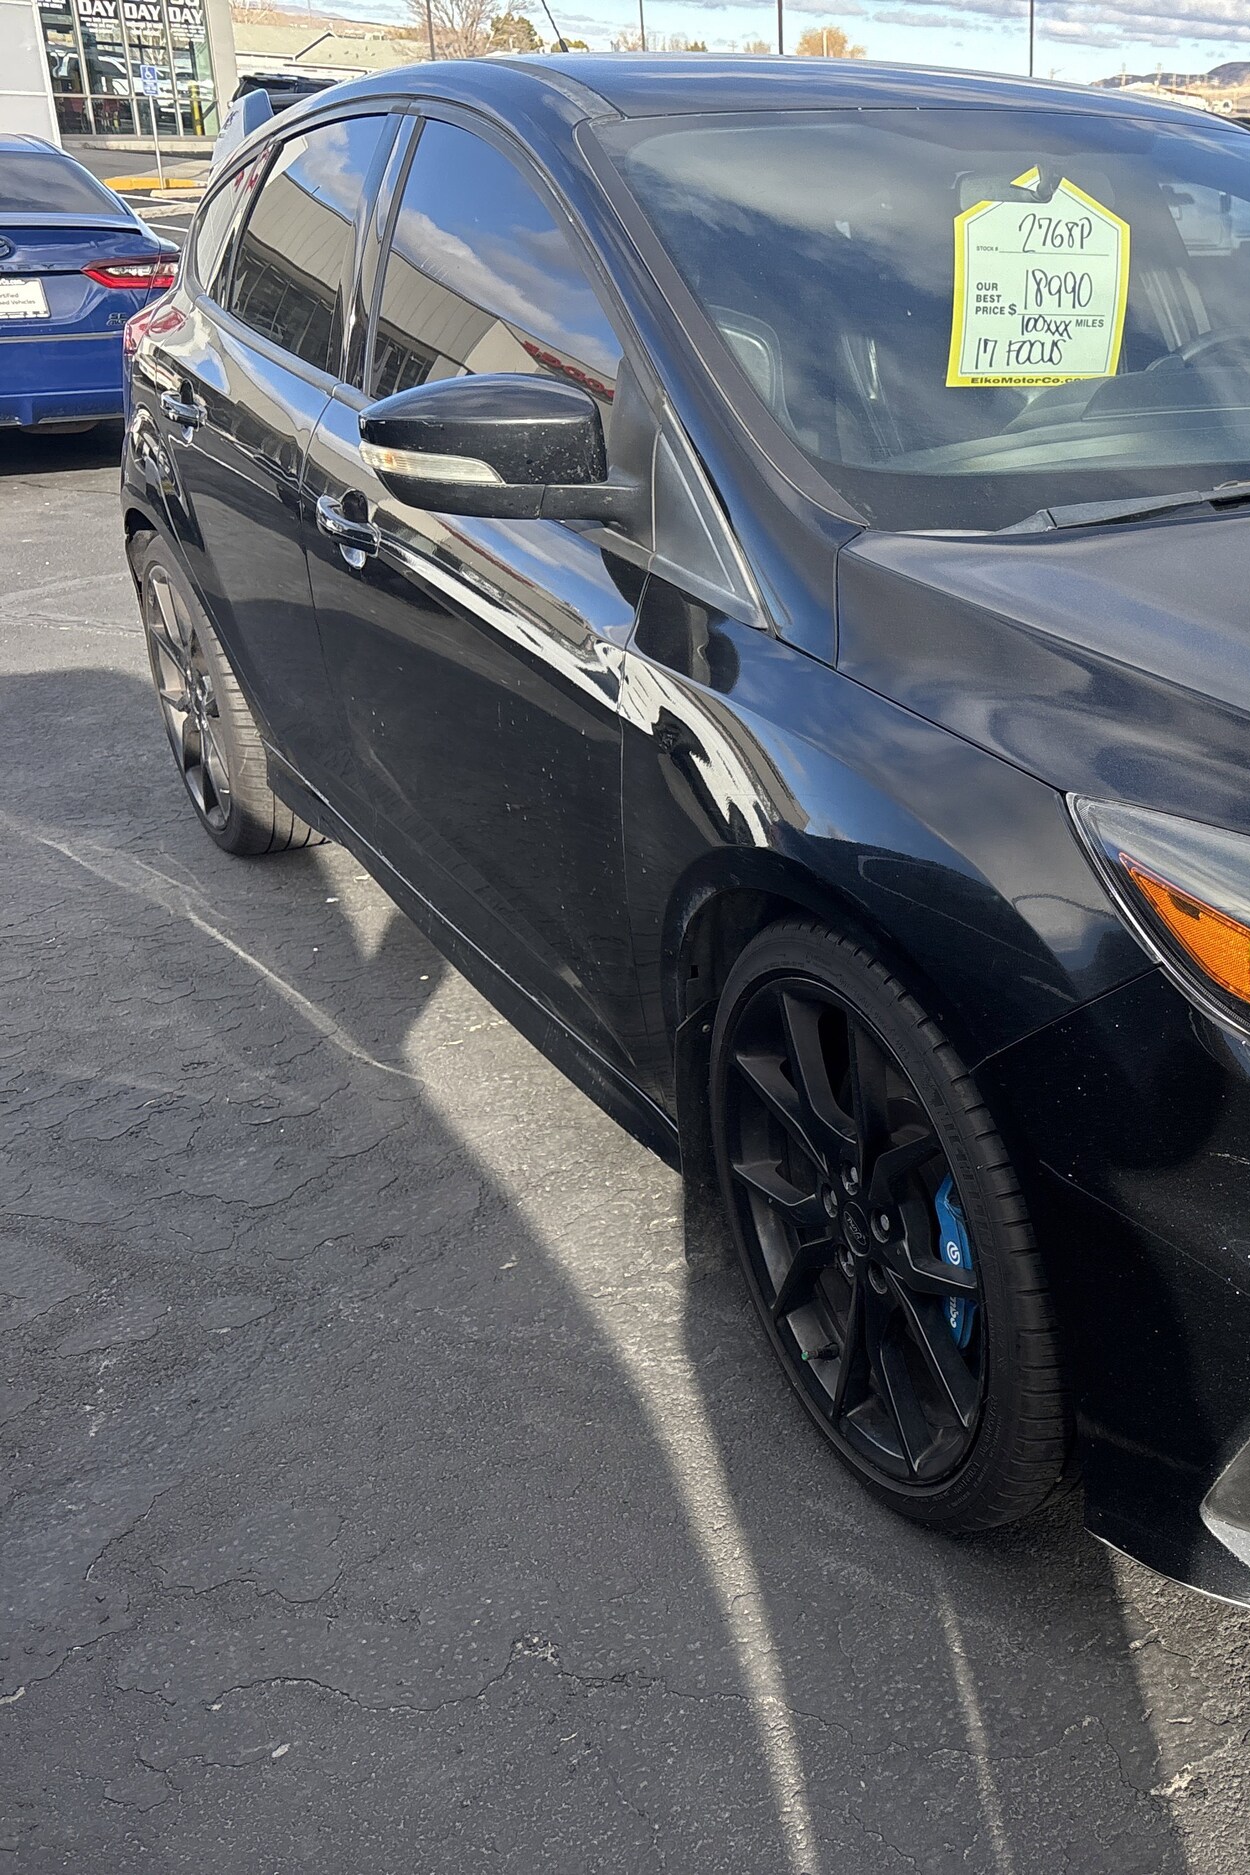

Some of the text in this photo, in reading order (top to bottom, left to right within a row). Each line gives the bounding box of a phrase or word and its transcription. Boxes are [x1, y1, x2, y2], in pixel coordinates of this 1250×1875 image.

[79, 0, 117, 17] DAY
[123, 3, 161, 21] DAY
[168, 6, 204, 24] DAY
[1018, 213, 1092, 253] 2768P
[975, 269, 1093, 316] PRICE $ 18990
[976, 282, 998, 291] OUR
[976, 294, 1002, 303] BEST
[1075, 319, 1105, 328] MILES
[975, 338, 997, 369] 17
[970, 376, 1087, 385] ElkoMotorCo.co
